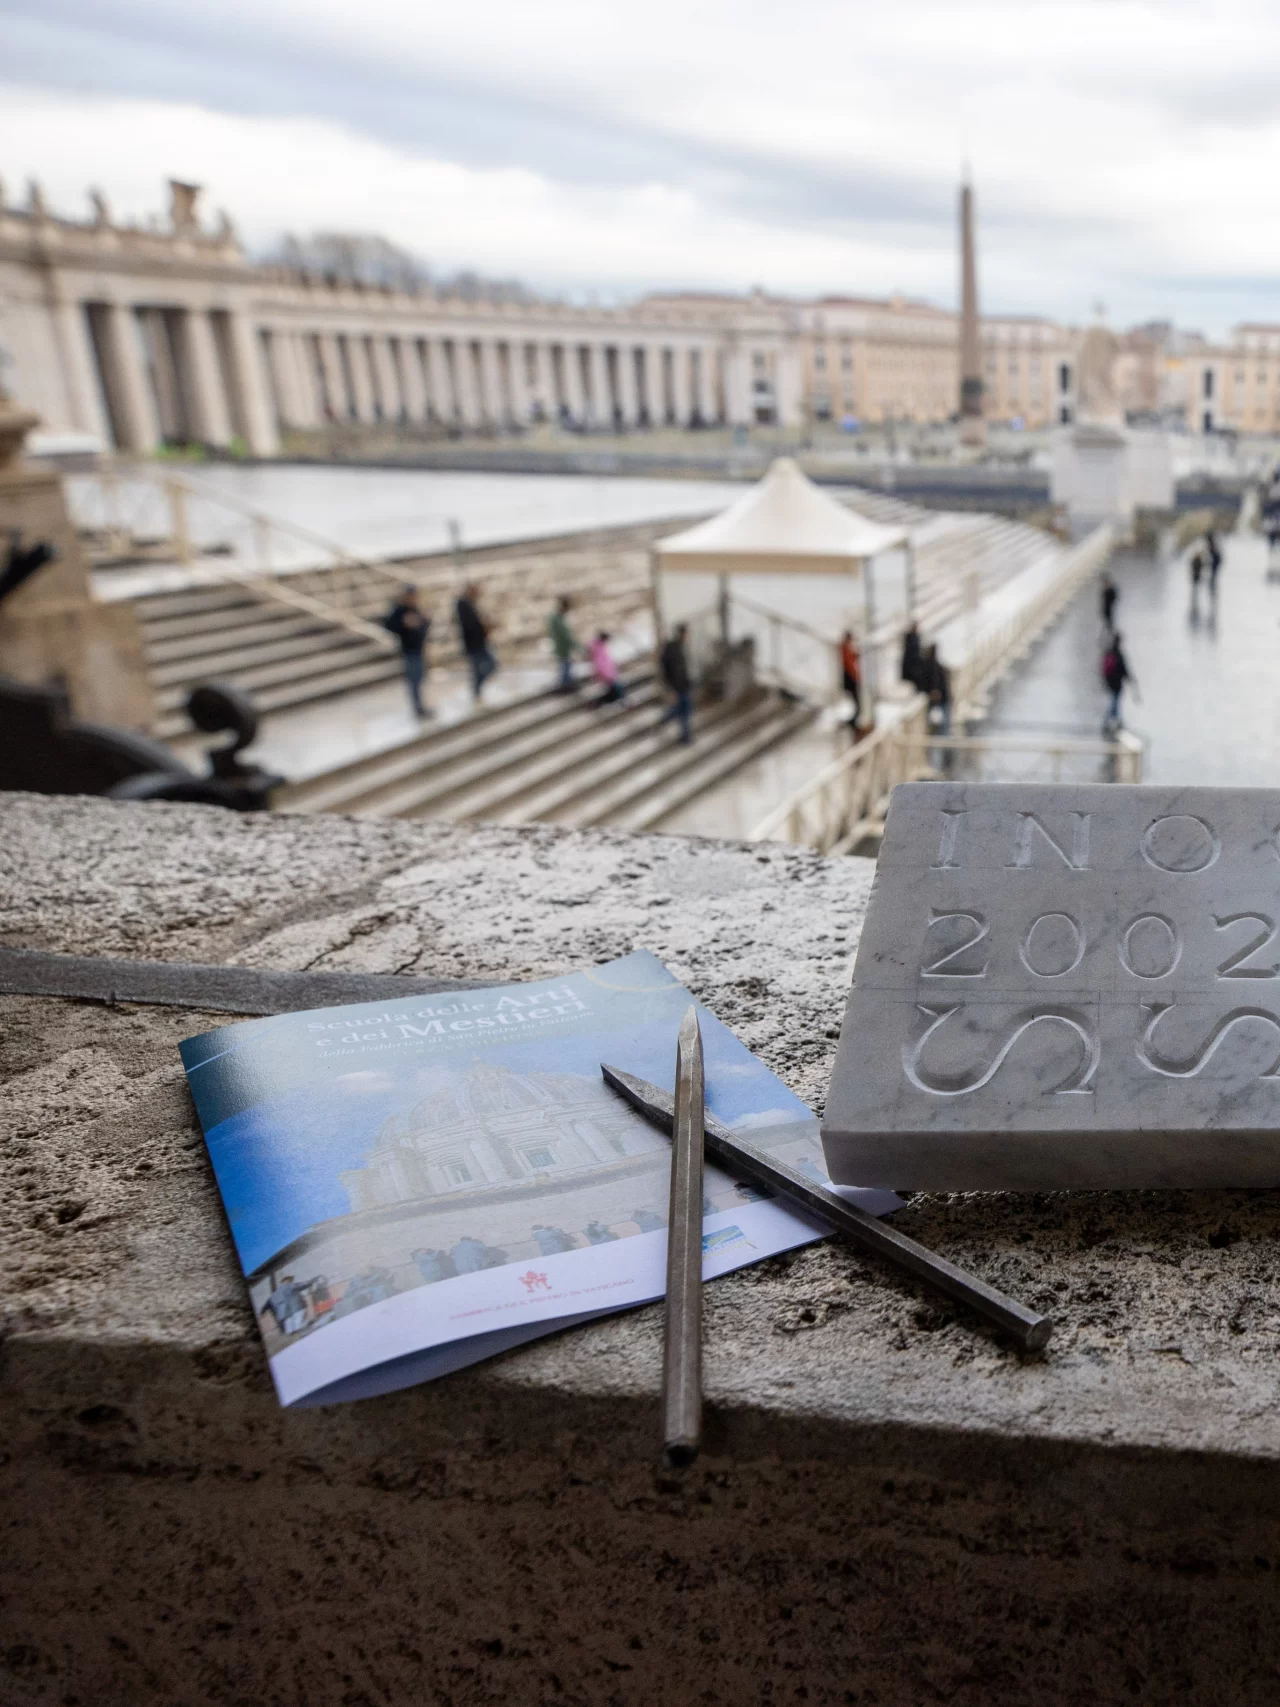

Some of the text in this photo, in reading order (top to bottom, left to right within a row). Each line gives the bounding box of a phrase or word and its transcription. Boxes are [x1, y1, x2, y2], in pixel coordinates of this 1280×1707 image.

[307, 984, 577, 1032] Scuola delle Arti
[316, 997, 587, 1047] e dei Mestieri
